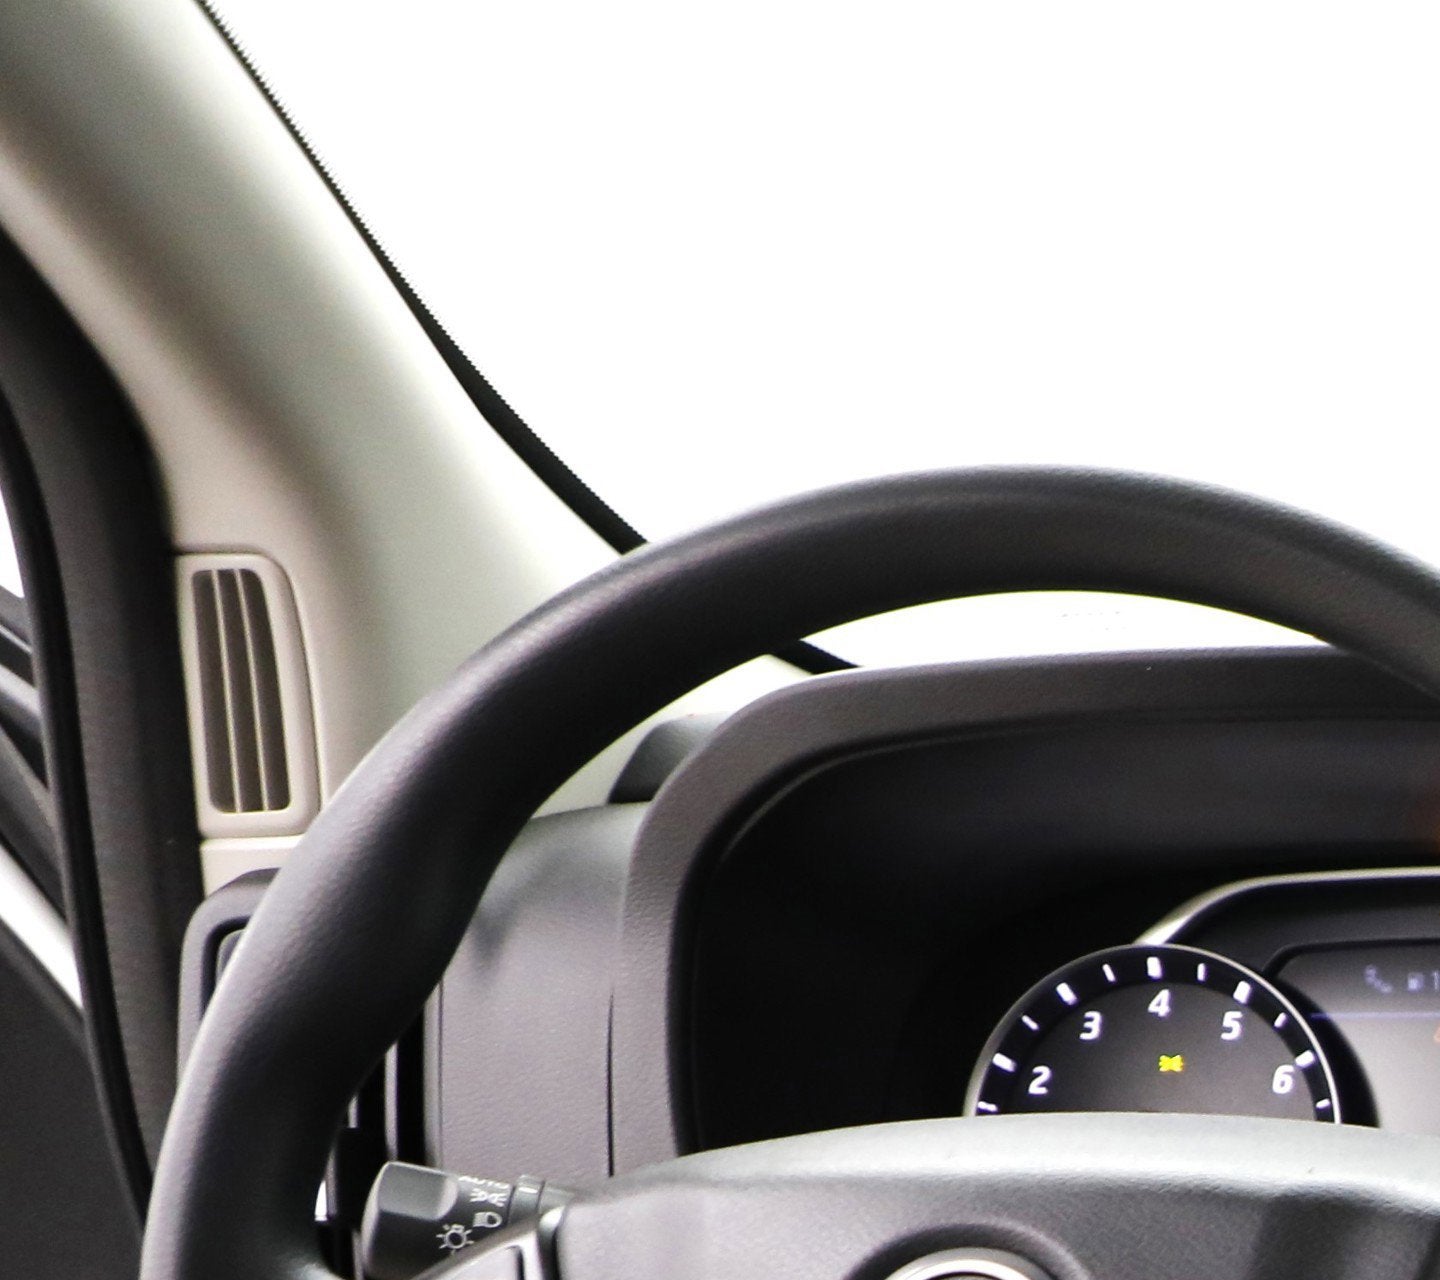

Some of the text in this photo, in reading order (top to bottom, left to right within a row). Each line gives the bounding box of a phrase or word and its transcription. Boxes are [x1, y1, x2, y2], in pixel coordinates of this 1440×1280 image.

[1148, 989, 1172, 1018] 4
[1079, 1011, 1103, 1040] 3
[1221, 1011, 1244, 1040] 5
[1028, 1066, 1053, 1095] 2
[1272, 1065, 1295, 1094] 6
